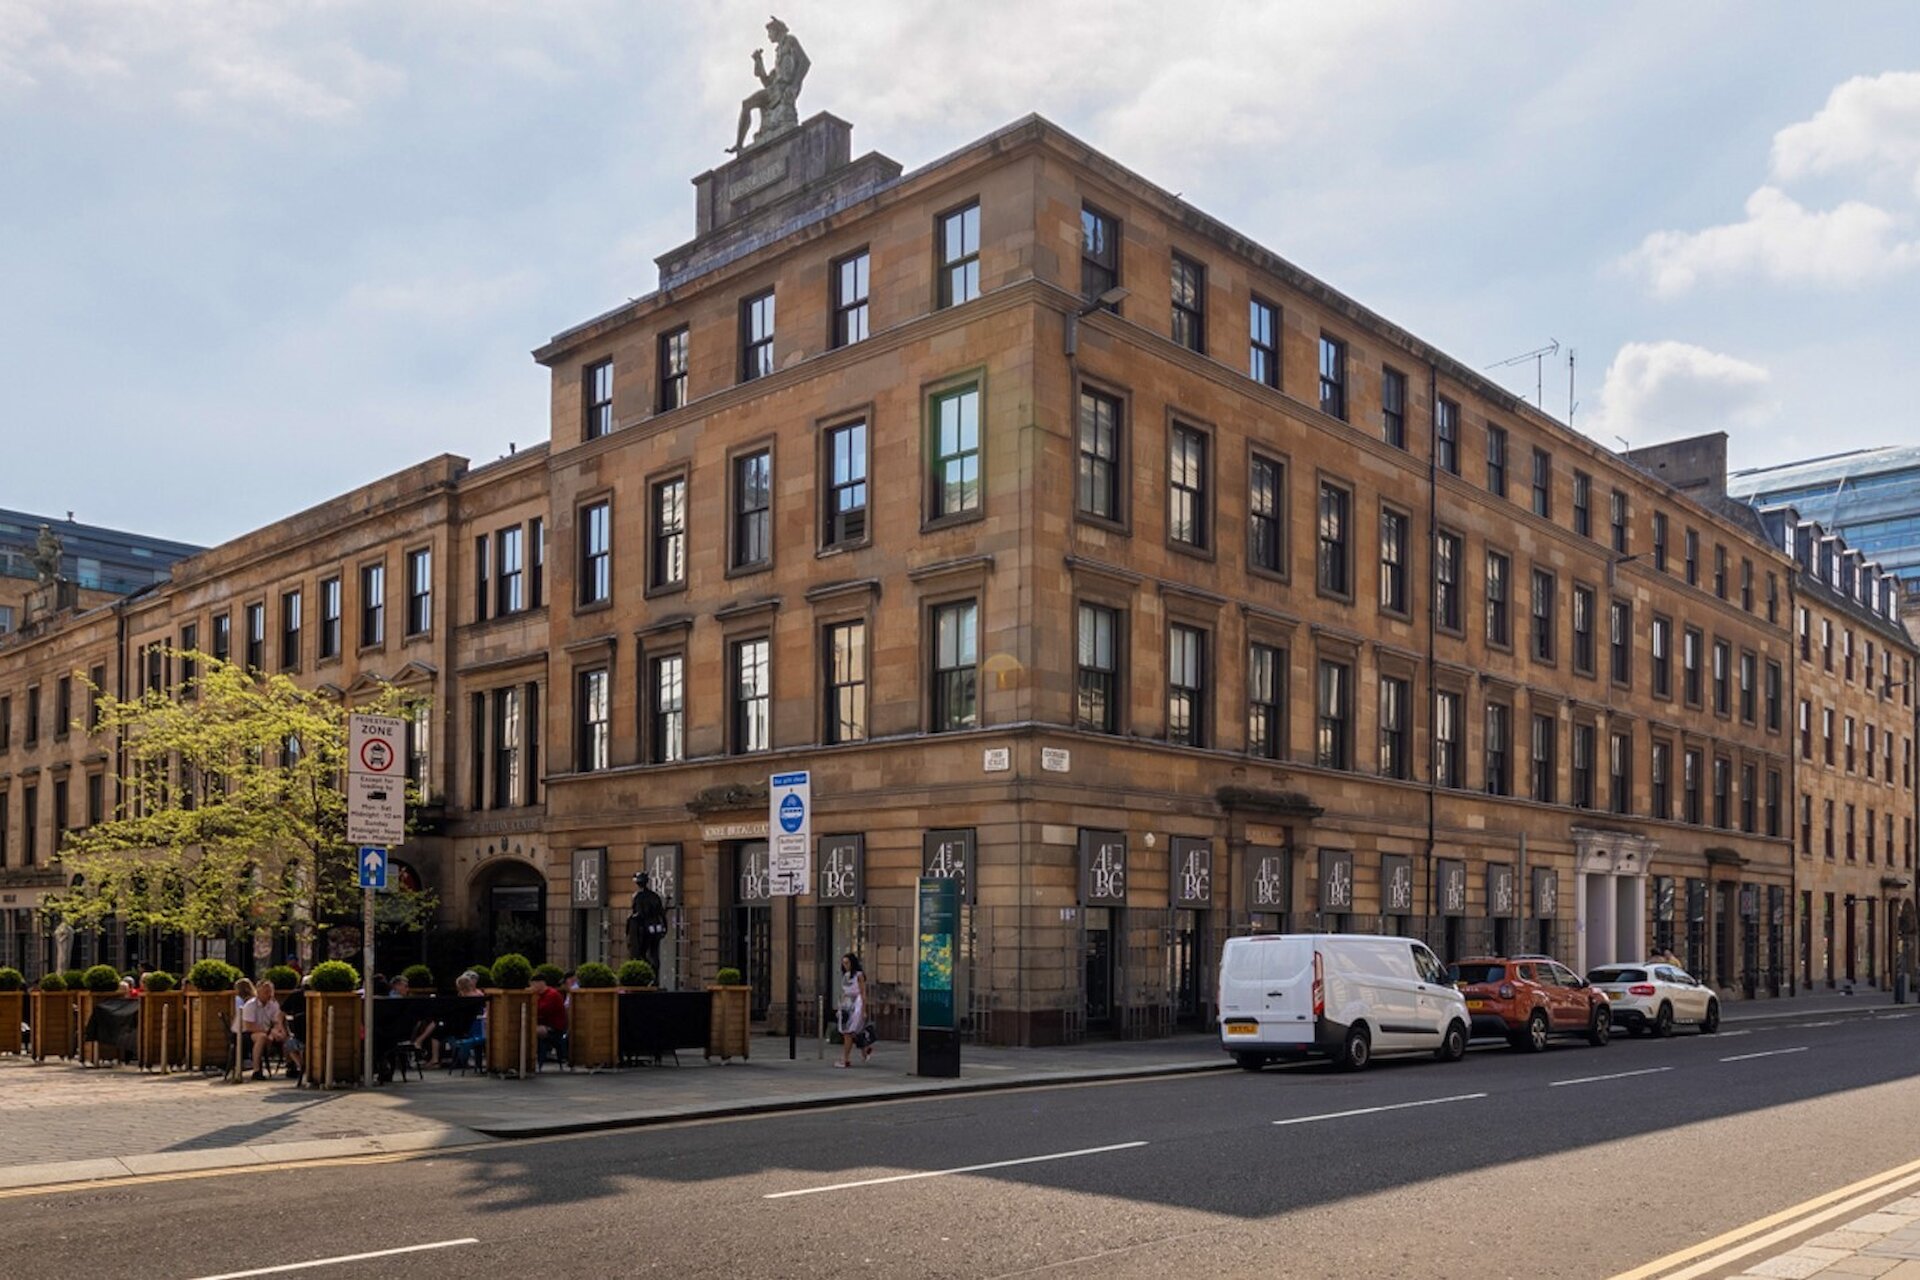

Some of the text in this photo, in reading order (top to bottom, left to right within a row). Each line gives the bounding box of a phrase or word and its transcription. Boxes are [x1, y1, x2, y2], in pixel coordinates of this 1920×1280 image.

[355, 717, 401, 727] PEDESTRIAN
[361, 724, 393, 737] ZONE
[360, 776, 384, 785] Except
[360, 783, 384, 792] loading
[351, 811, 380, 819] Midnight
[364, 820, 388, 828] Sunday
[351, 827, 380, 835] Midnight
